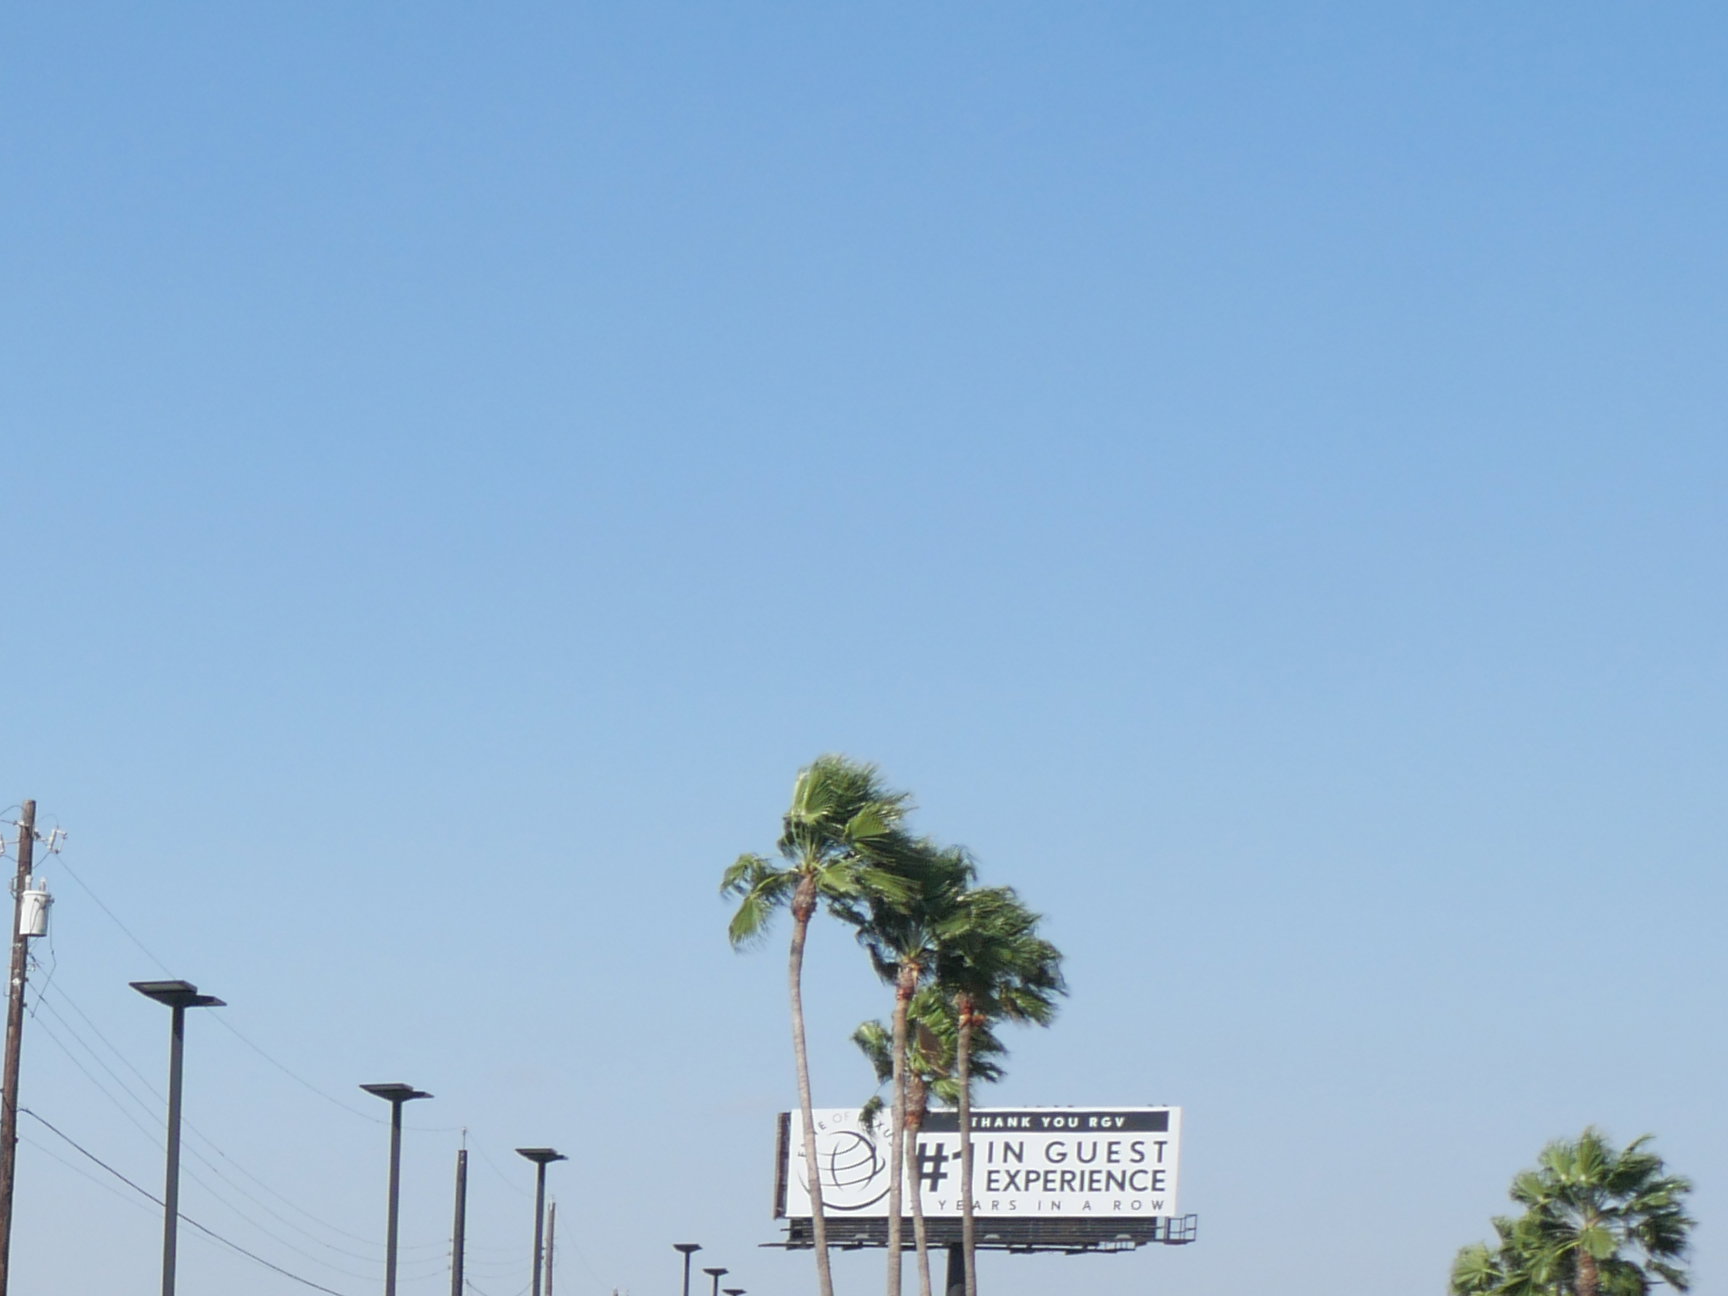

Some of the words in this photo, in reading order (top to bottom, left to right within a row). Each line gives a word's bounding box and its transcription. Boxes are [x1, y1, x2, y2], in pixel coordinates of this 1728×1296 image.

[971, 1117, 1031, 1128] THANK
[1041, 1117, 1079, 1128] YOU
[1088, 1116, 1125, 1128] RGV
[987, 1141, 1024, 1164] IN
[1044, 1140, 1168, 1164] GUEST
[986, 1169, 1166, 1192] EXPERIENCE
[938, 1200, 1017, 1211] YEARS
[1037, 1200, 1062, 1211] IN
[1082, 1200, 1092, 1211] A
[1113, 1200, 1164, 1211] ROW
